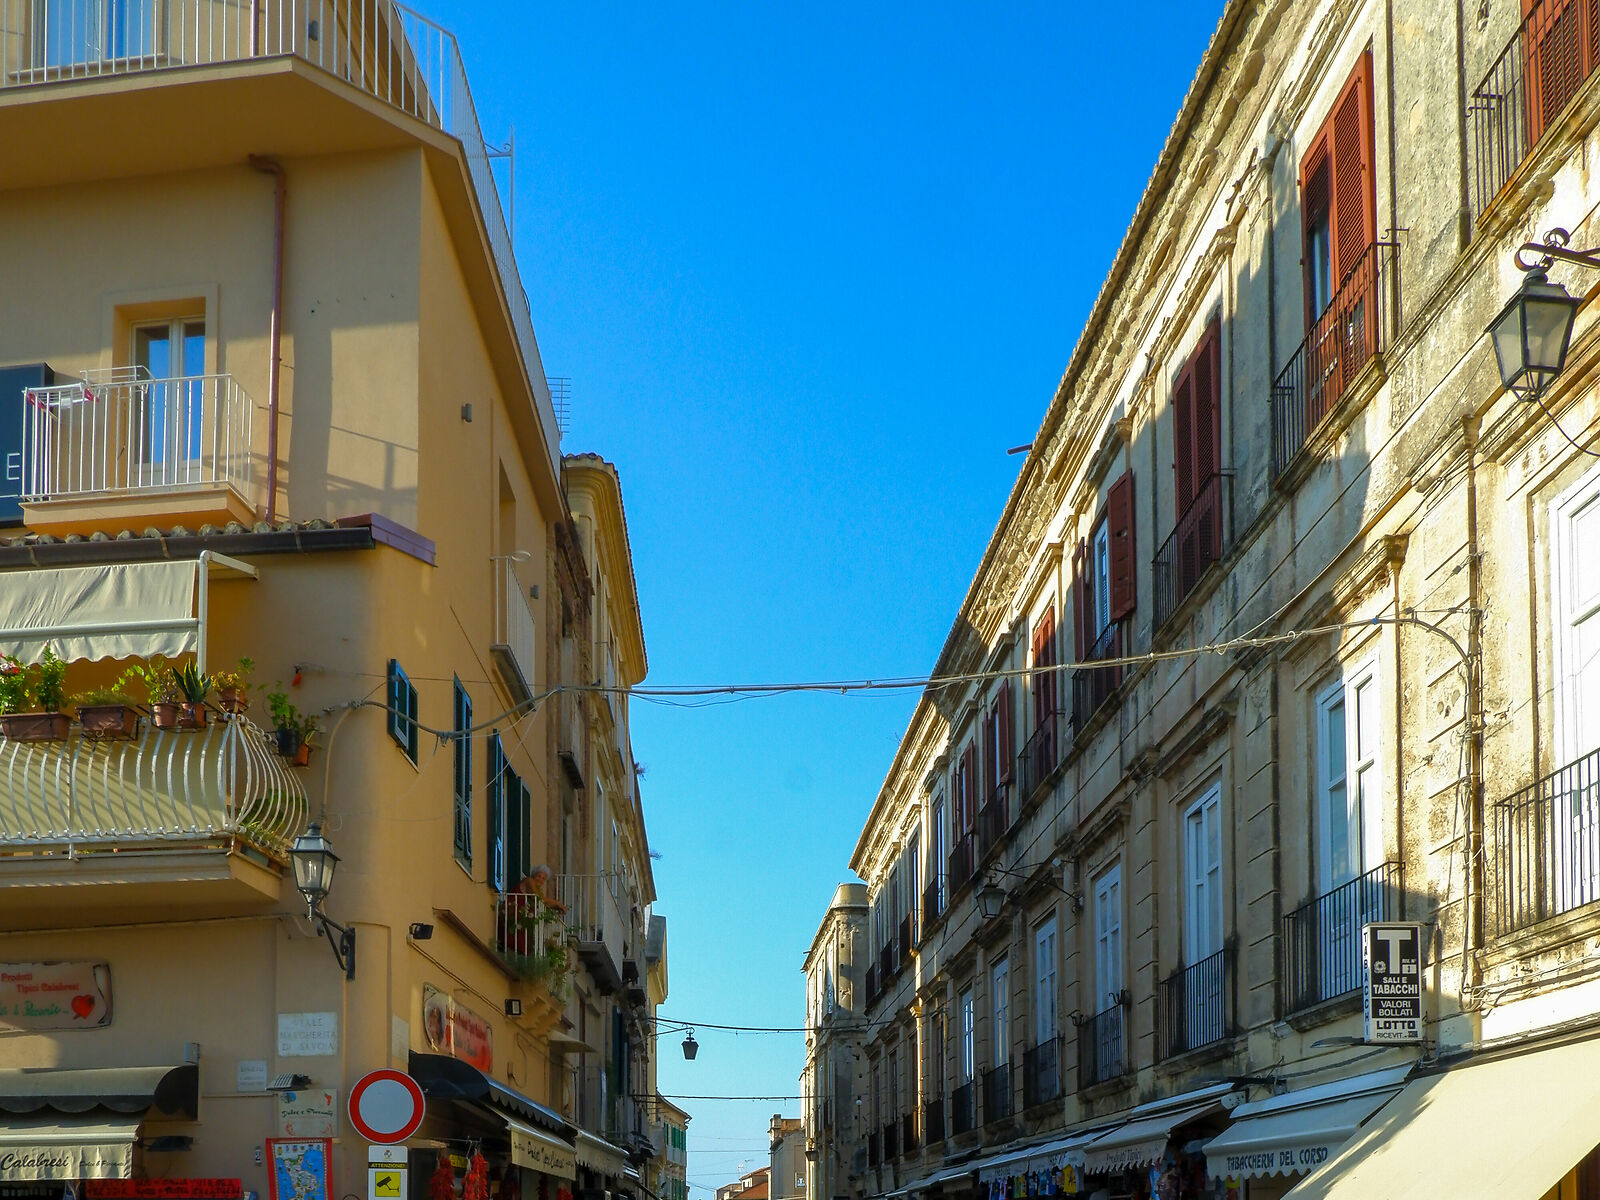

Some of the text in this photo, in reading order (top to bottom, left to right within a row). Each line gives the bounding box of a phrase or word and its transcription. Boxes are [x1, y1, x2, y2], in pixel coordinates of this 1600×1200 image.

[1377, 929, 1411, 974] T
[1382, 976, 1408, 984] SALI E
[16, 982, 80, 994] Tipici Calabresi
[1373, 984, 1418, 995] TABACCHI
[1380, 1000, 1411, 1009] VALORI
[1378, 1008, 1413, 1017] BOLLATI
[1376, 1020, 1416, 1030] LOTTO
[280, 1031, 336, 1040] MARGHERITA
[281, 1042, 335, 1051] DI SAVOIA
[0, 1152, 70, 1171] Calabresi
[1226, 1147, 1328, 1171] TABACCHERIA DEL CORSO
